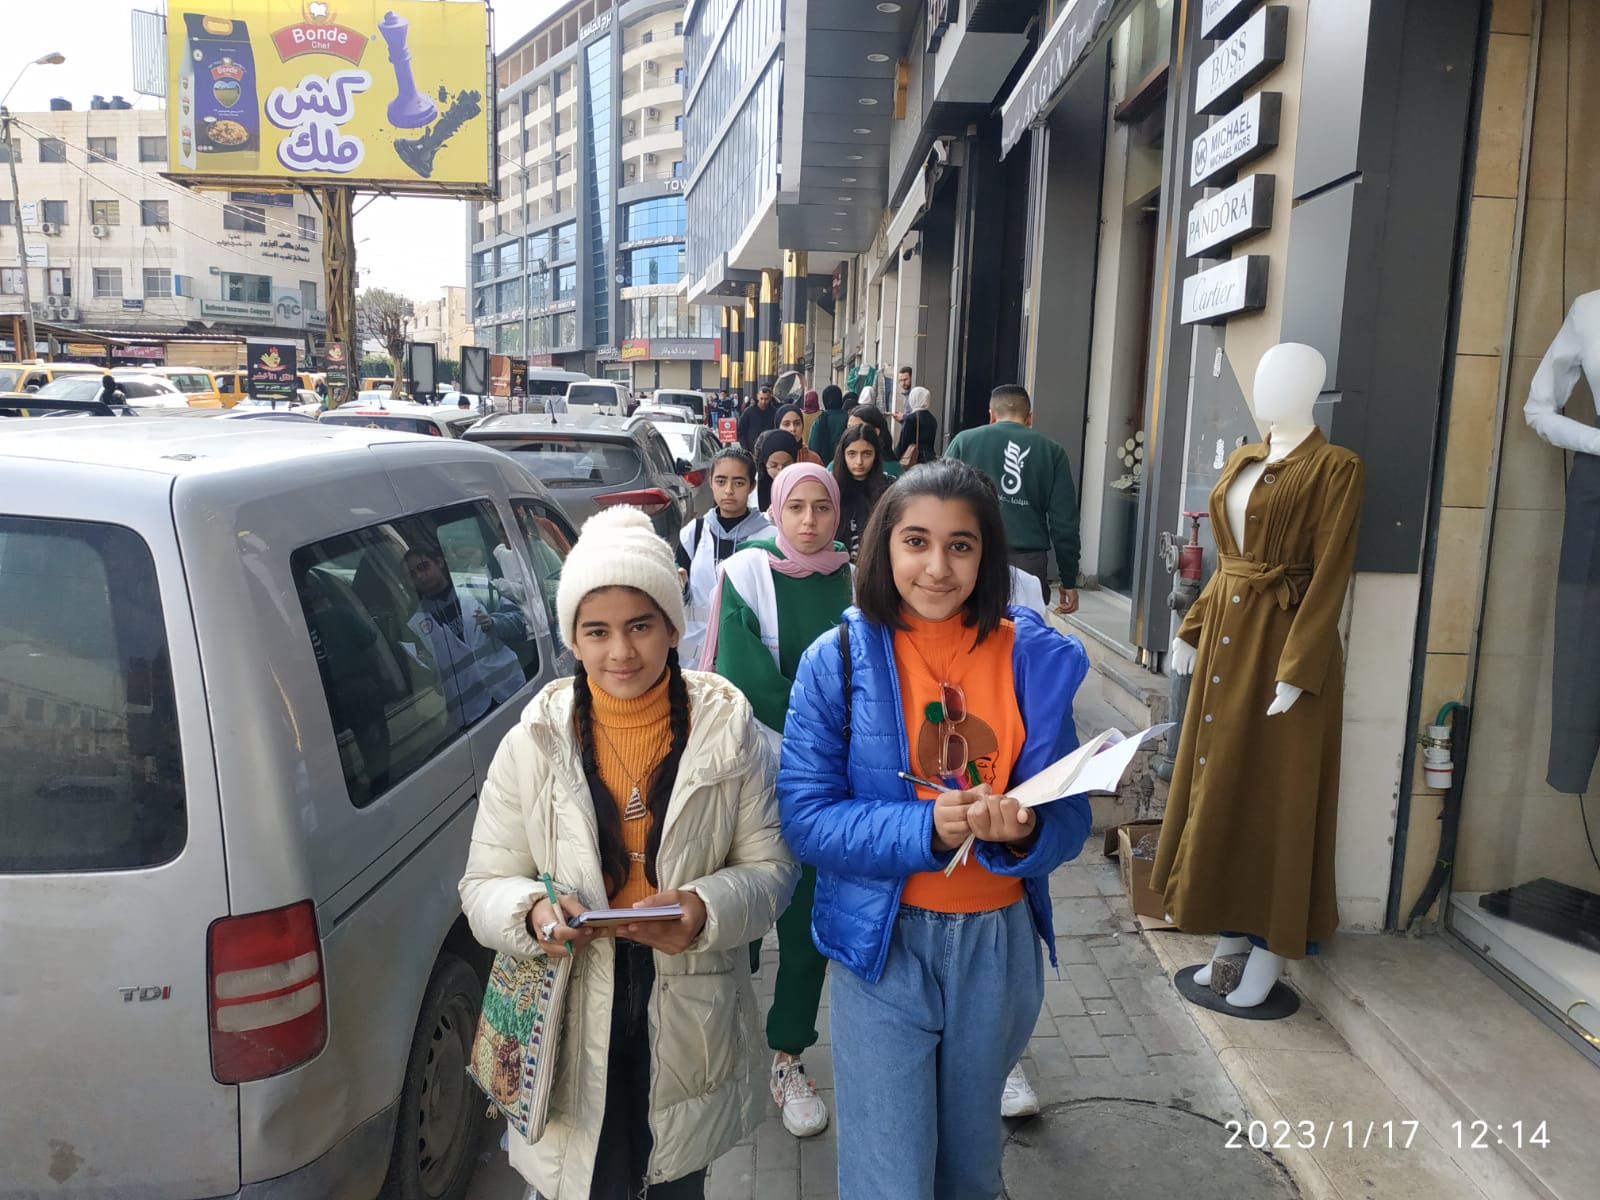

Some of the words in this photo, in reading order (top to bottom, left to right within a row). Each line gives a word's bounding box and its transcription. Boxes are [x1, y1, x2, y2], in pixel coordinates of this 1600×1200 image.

[292, 27, 348, 44] Bonde
[312, 41, 330, 49] Chef
[1212, 31, 1247, 85] BOSS
[272, 74, 367, 122] كش
[285, 121, 360, 166] ملك
[1211, 112, 1252, 153] MICHAEL
[1234, 134, 1251, 153] KORS
[1189, 192, 1248, 245] PANDORA
[1192, 277, 1236, 313] Cartier
[118, 985, 171, 1002] TDI
